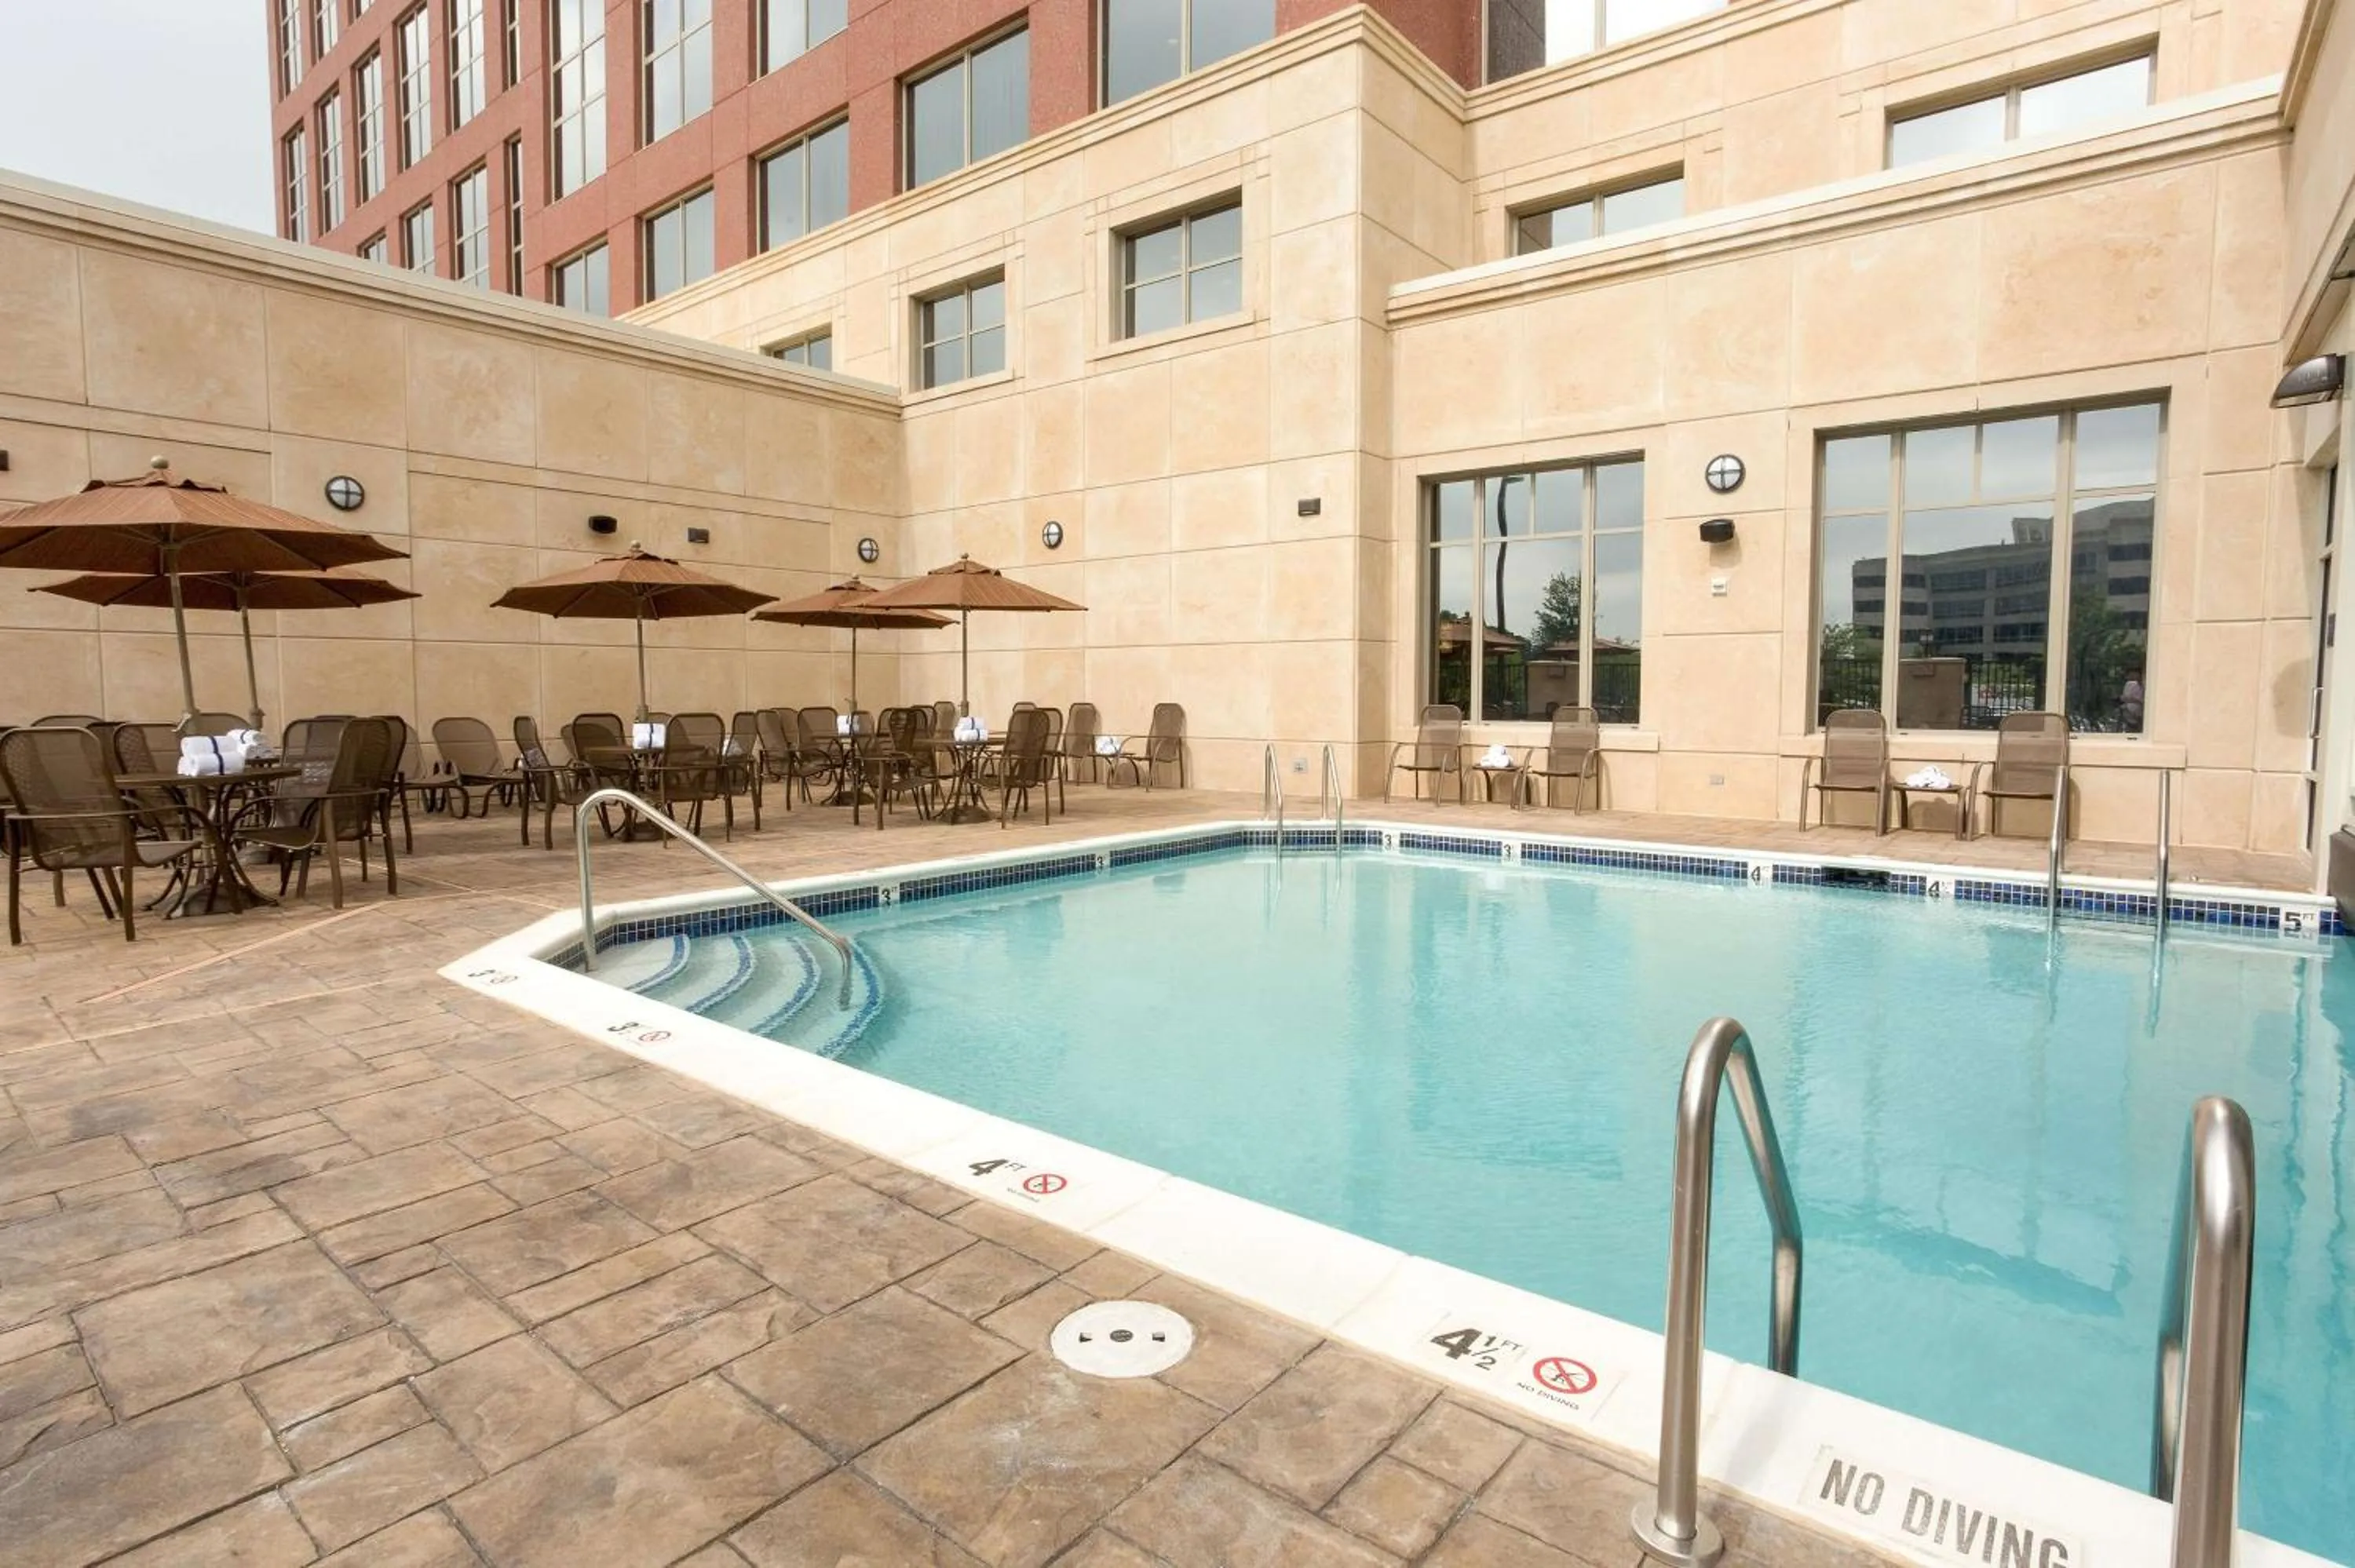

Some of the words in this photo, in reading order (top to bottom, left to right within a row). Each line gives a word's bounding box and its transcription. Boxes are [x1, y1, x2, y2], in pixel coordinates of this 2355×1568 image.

[1751, 866, 1761, 879] 4
[2285, 912, 2302, 932] 5
[968, 1158, 1009, 1176] 4
[1501, 1339, 1524, 1351] FT
[1516, 1382, 1535, 1393] NO
[1537, 1390, 1580, 1410] DIVING
[1819, 1458, 1886, 1516] NO
[1901, 1486, 2070, 1568] DIVING
